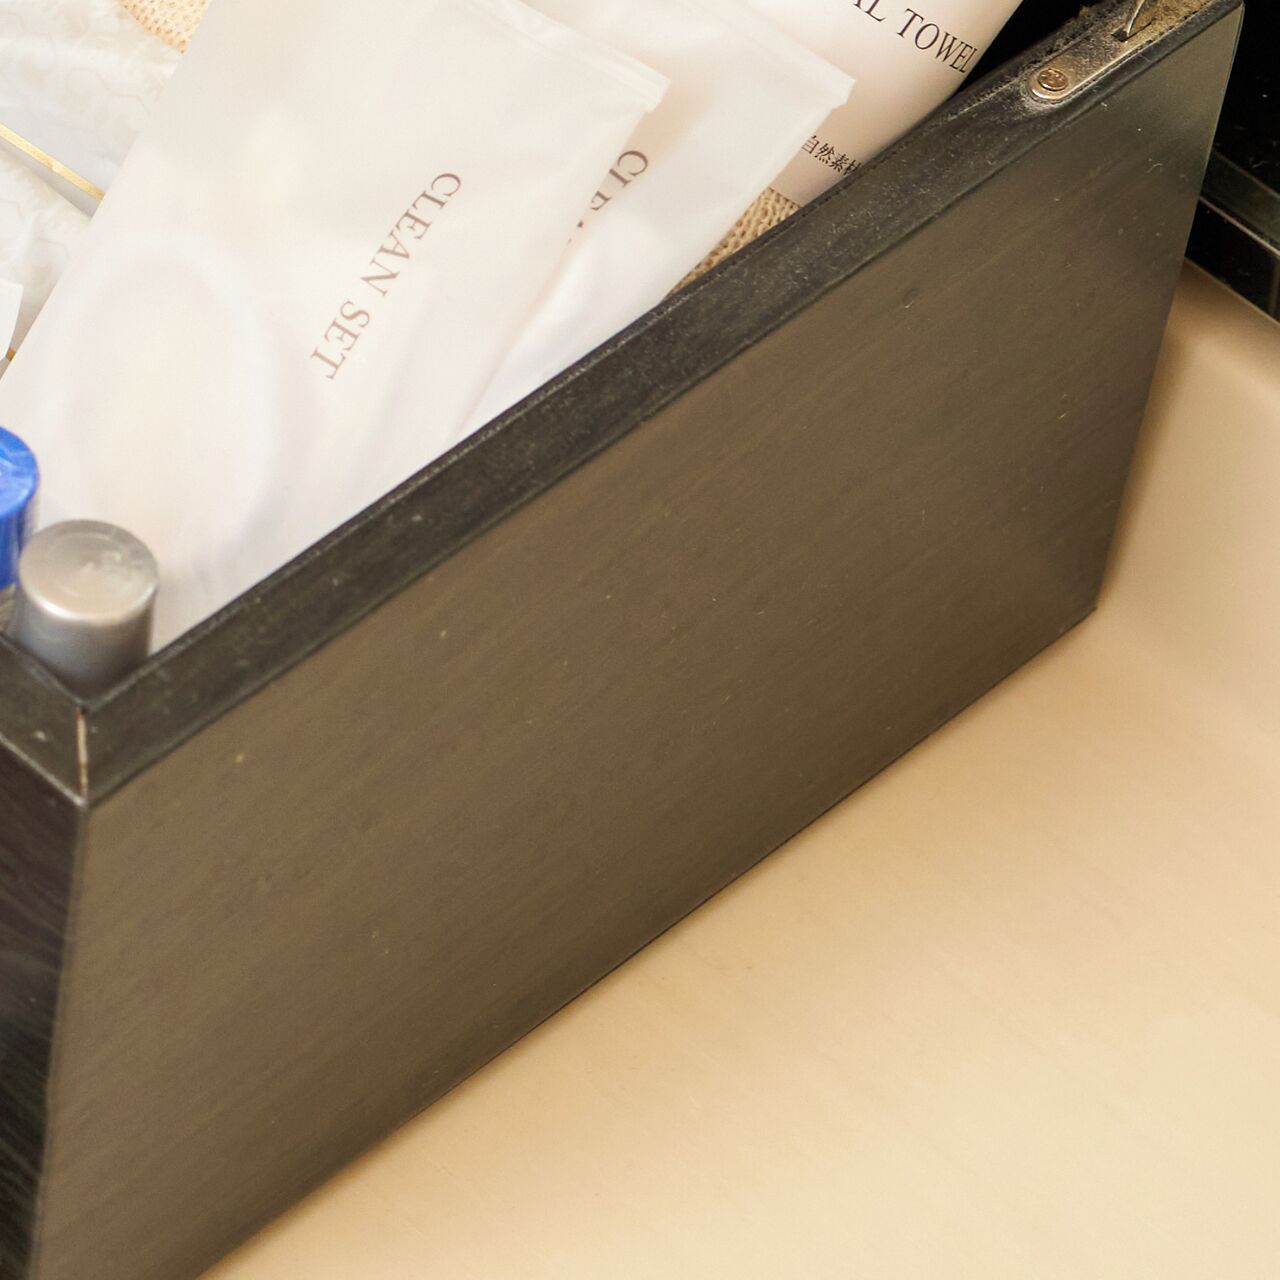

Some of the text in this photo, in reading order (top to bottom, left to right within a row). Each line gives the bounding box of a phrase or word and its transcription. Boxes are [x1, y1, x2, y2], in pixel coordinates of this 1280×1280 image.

[896, 7, 978, 74] TOWEL
[310, 172, 463, 381] CLEAN SET
